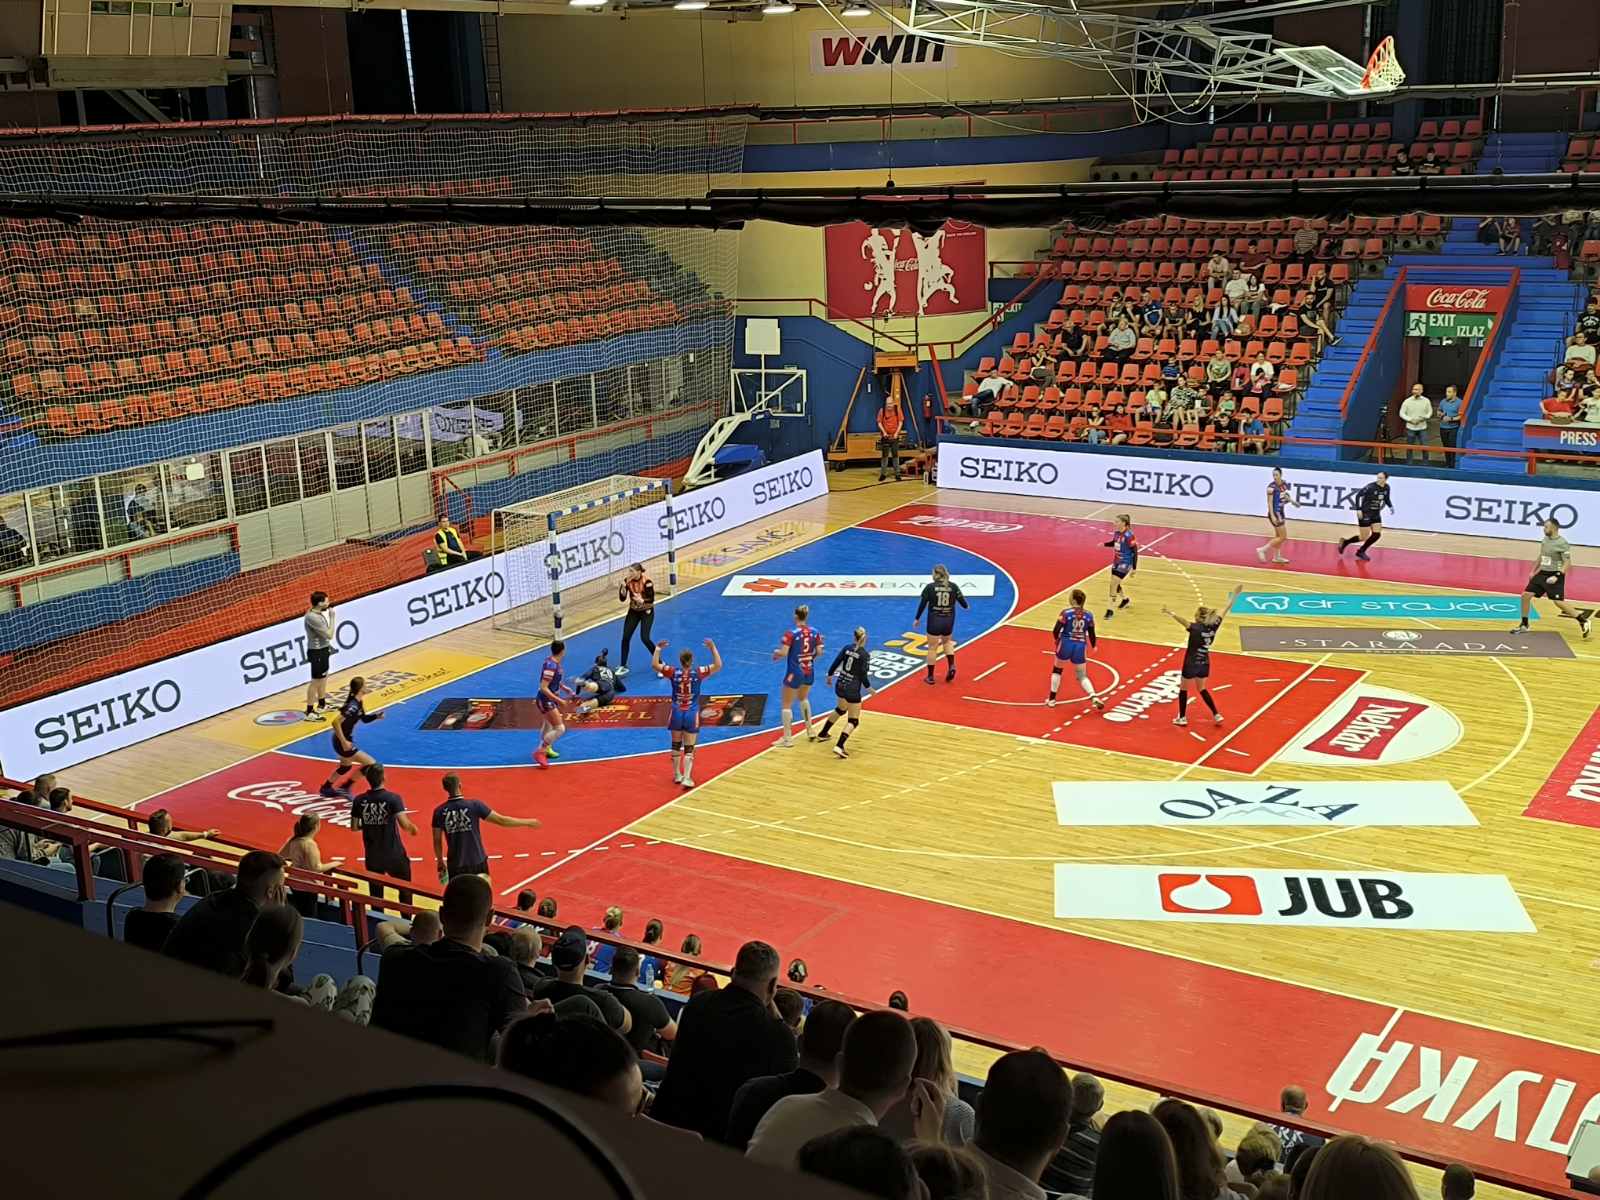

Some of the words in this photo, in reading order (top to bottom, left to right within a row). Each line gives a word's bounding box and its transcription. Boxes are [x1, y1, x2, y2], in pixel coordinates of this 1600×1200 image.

[1426, 287, 1490, 309] Coca-Cola
[1429, 313, 1457, 326] EXIT
[1456, 325, 1485, 337] IZLAZ
[1560, 430, 1597, 446] PRESS
[959, 456, 1058, 485] SEIKO
[1106, 468, 1214, 498] SEIKO
[752, 466, 813, 506] SEIKO
[1286, 482, 1361, 511] EIK
[1445, 494, 1578, 529] SEIKO
[407, 572, 505, 626] SEIKO
[936, 591, 950, 607] 18
[240, 620, 360, 685] SEIO
[1293, 638, 1417, 649] STARA
[1436, 641, 1514, 650] ADA
[35, 679, 181, 755] SEIKO
[1328, 703, 1410, 753] Nektar
[1159, 784, 1359, 822] OAZA
[1278, 876, 1414, 920] JUB
